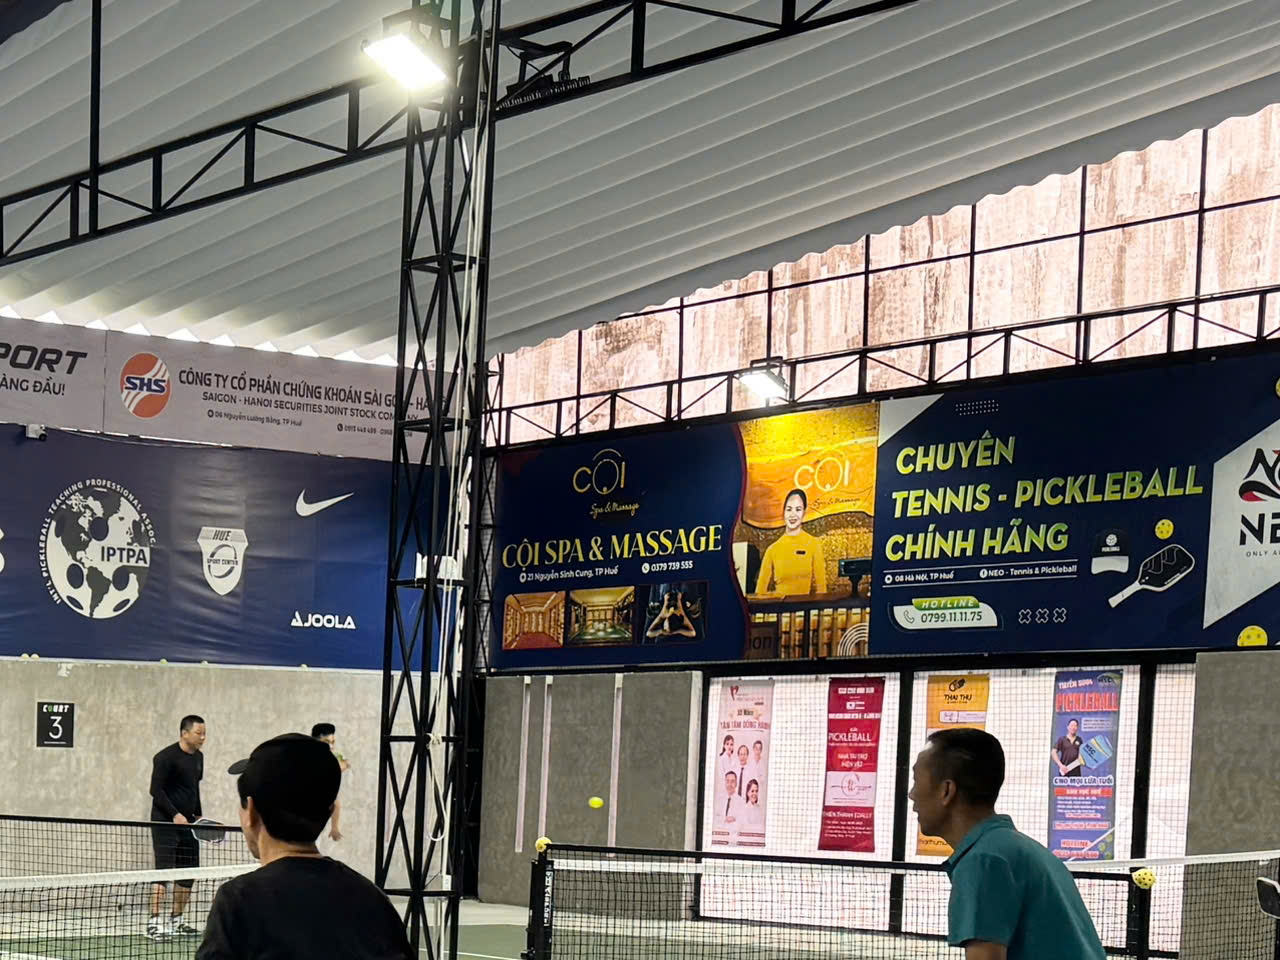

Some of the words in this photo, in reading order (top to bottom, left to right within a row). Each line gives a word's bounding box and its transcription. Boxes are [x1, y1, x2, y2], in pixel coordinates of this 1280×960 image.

[33, 376, 66, 396] ĐẦU!
[124, 375, 167, 394] SHS
[179, 367, 212, 387] CÔNG
[214, 373, 229, 389] TY
[249, 374, 281, 395] PHẦN
[324, 386, 361, 404] KHOÁN
[363, 389, 382, 407] SÀI
[202, 391, 237, 404] SAIGON
[244, 397, 272, 408] HANOI
[273, 400, 322, 413] SECURITIES
[324, 406, 349, 417] JOINT
[350, 408, 377, 419] STOCK
[896, 429, 1016, 475] CHUYÊN
[892, 483, 991, 519] TENNIS
[1014, 465, 1204, 509] PICKLEBALL
[38, 517, 51, 578] PICKLEBALL
[48, 481, 83, 514] TEACHING
[86, 478, 142, 511] PROFESSIONAL
[141, 512, 157, 548] ASSOC.
[212, 529, 232, 541] HUE
[502, 538, 540, 571] CỘI
[544, 538, 585, 566] SPA
[588, 535, 604, 561] &
[609, 524, 723, 560] MASSAGE
[885, 519, 976, 562] CHÍNH
[982, 518, 1070, 556] HÃNG
[101, 545, 148, 565] IPTPA
[1246, 550, 1268, 558] ONLY
[559, 570, 575, 579] Sinh
[594, 568, 604, 577] TP
[930, 572, 939, 580] TP
[988, 569, 1005, 577] NEO
[1010, 567, 1033, 576] Tennis
[1041, 565, 1077, 575] Pickleball
[921, 599, 975, 608] HOTLINE
[920, 611, 982, 623] 0799.11.11.75
[42, 704, 70, 713] COURT
[1055, 692, 1120, 713] PICKLEBALL
[48, 715, 63, 739] 3
